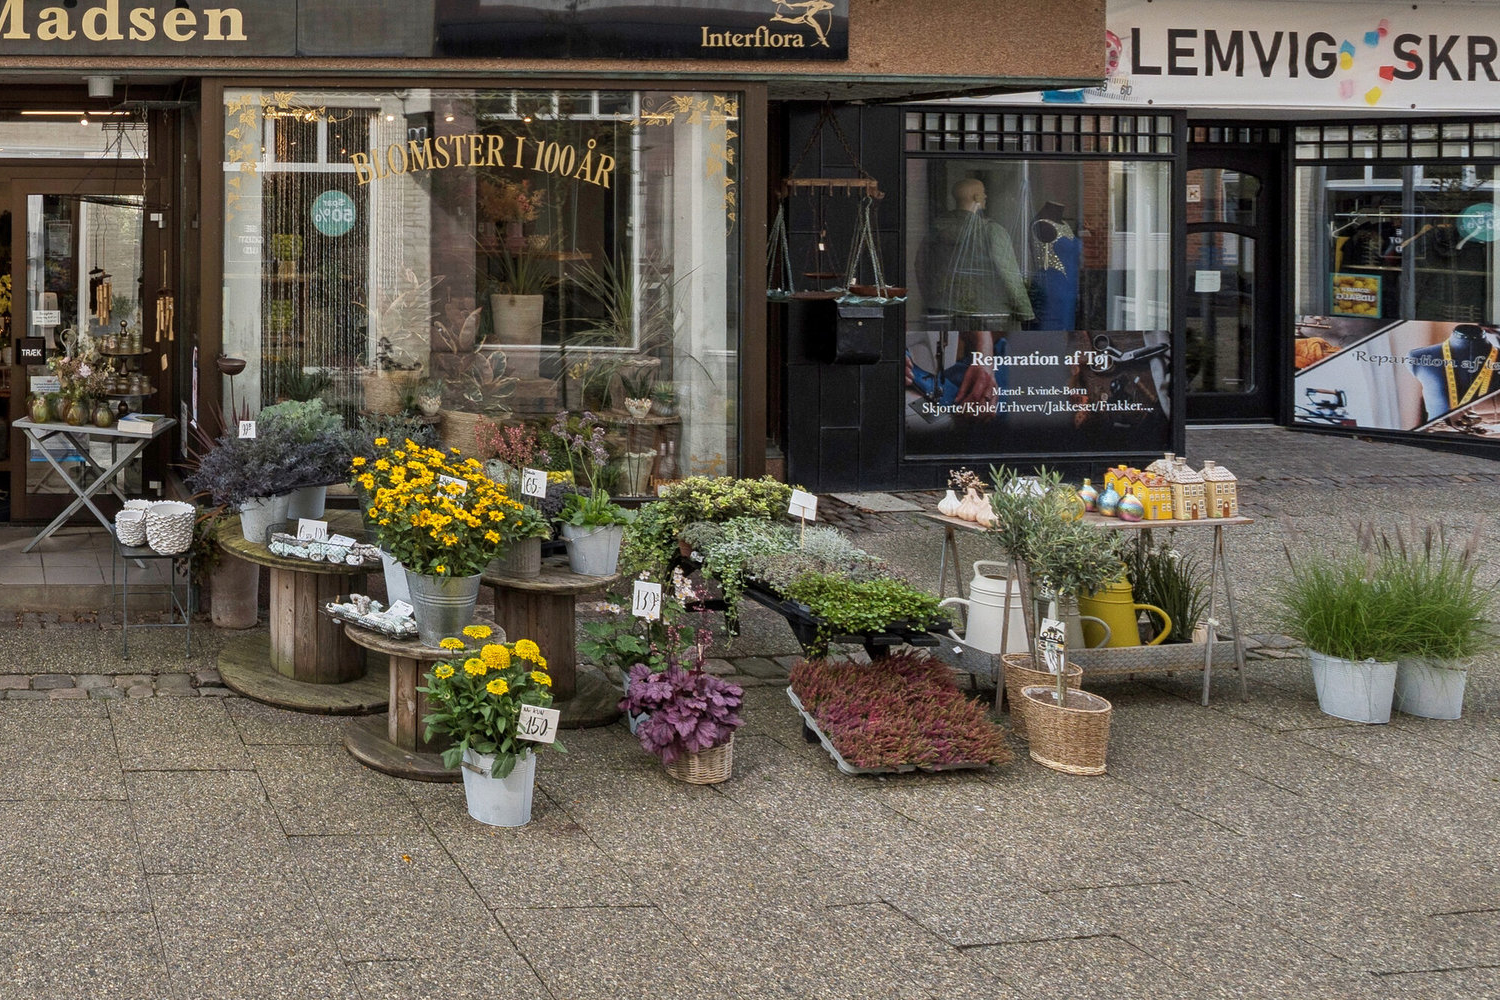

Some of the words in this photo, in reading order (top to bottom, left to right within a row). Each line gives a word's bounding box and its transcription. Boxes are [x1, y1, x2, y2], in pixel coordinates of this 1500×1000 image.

[700, 25, 805, 48] Interflora
[1131, 27, 1338, 79] LEMVIG
[1393, 33, 1500, 82] SKR
[349, 134, 504, 186] BLOMSTER
[512, 136, 526, 168] I
[21, 348, 42, 357] TRÆK
[970, 350, 1060, 372] Reparation
[1064, 350, 1081, 366] af
[1083, 350, 1109, 371] Tøj
[1355, 350, 1458, 369] Reparation
[992, 386, 1024, 397] Mænd-
